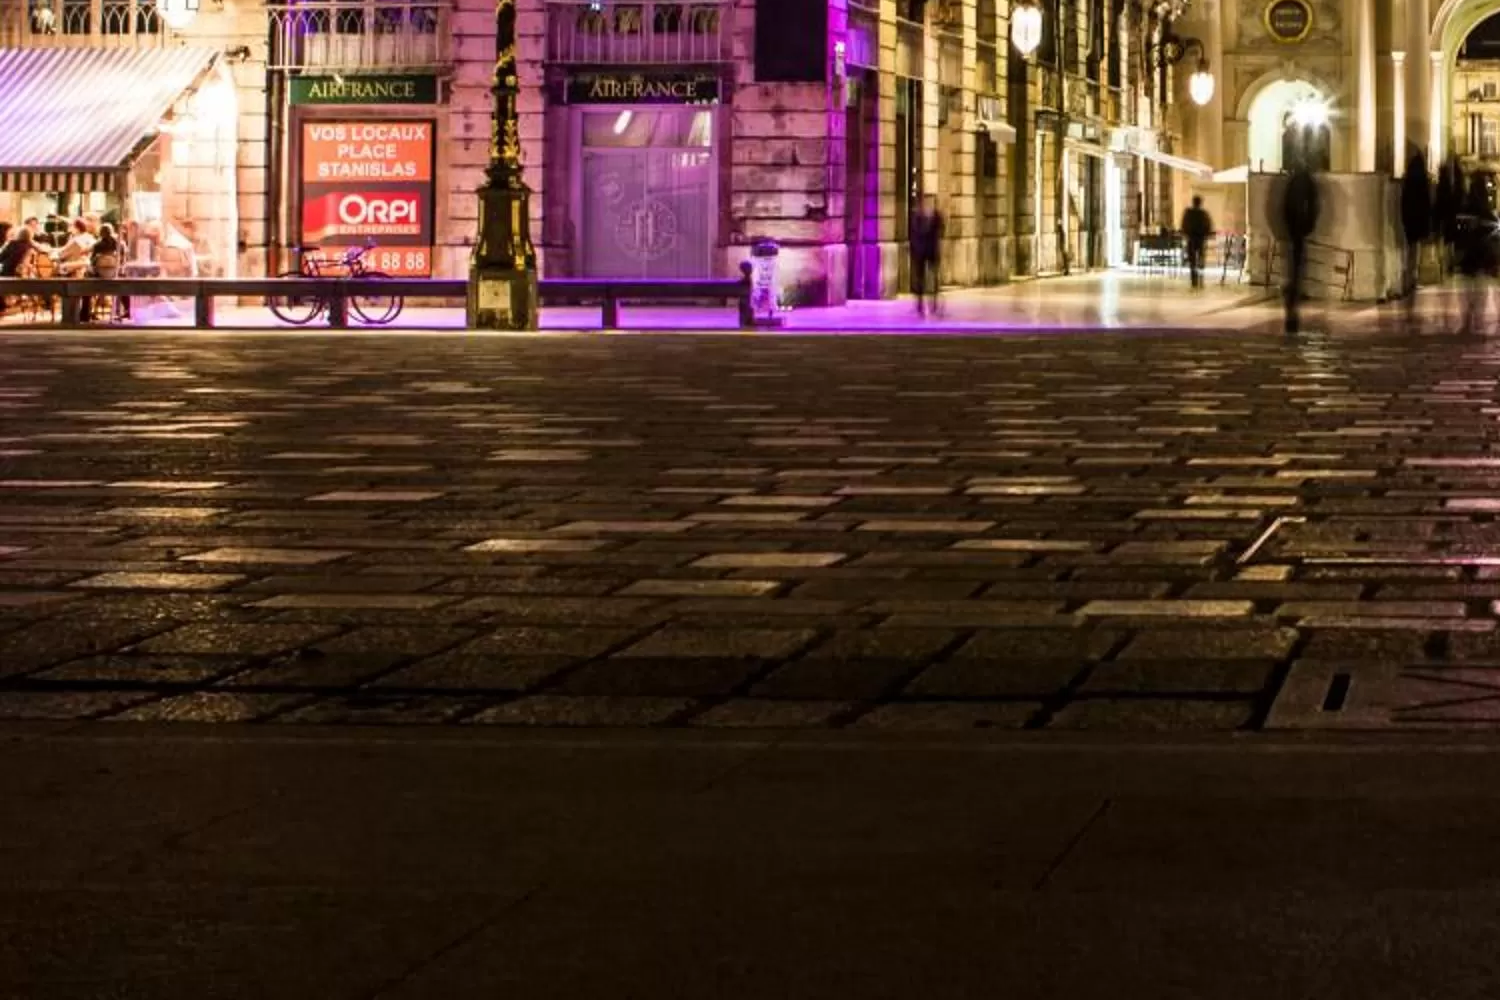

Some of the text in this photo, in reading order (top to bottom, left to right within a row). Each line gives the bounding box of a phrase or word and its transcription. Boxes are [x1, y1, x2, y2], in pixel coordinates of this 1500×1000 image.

[310, 126, 425, 141] VOS LOCAUX
[337, 144, 397, 159] PLACE
[318, 161, 416, 177] STANISLAS
[381, 251, 401, 270] 88
[405, 251, 425, 270] 88
